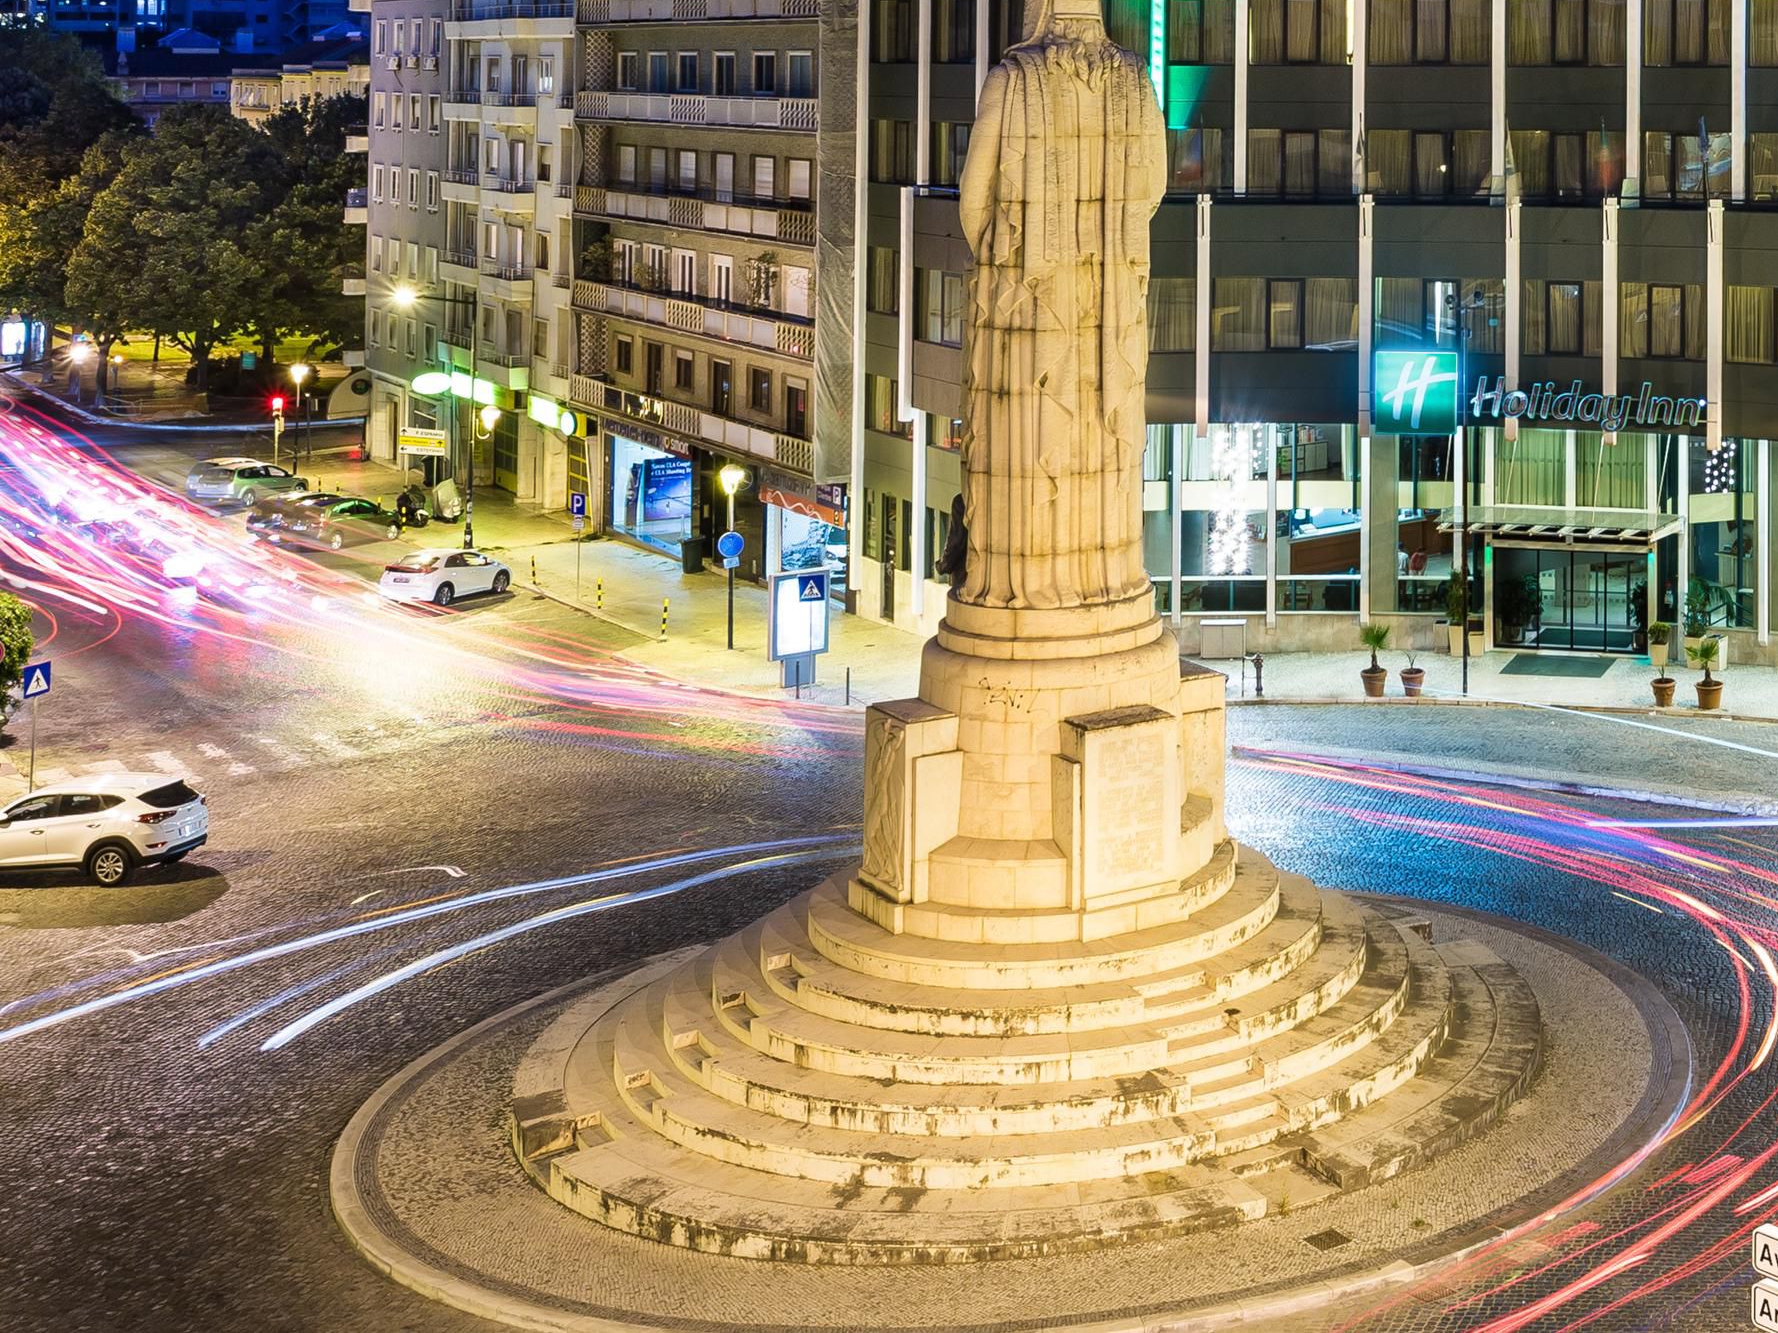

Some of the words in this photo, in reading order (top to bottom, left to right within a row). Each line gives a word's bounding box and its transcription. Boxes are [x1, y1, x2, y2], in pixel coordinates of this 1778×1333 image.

[1471, 376, 1633, 432] Holiday
[1636, 382, 1701, 426] Inn
[574, 495, 583, 513] P
